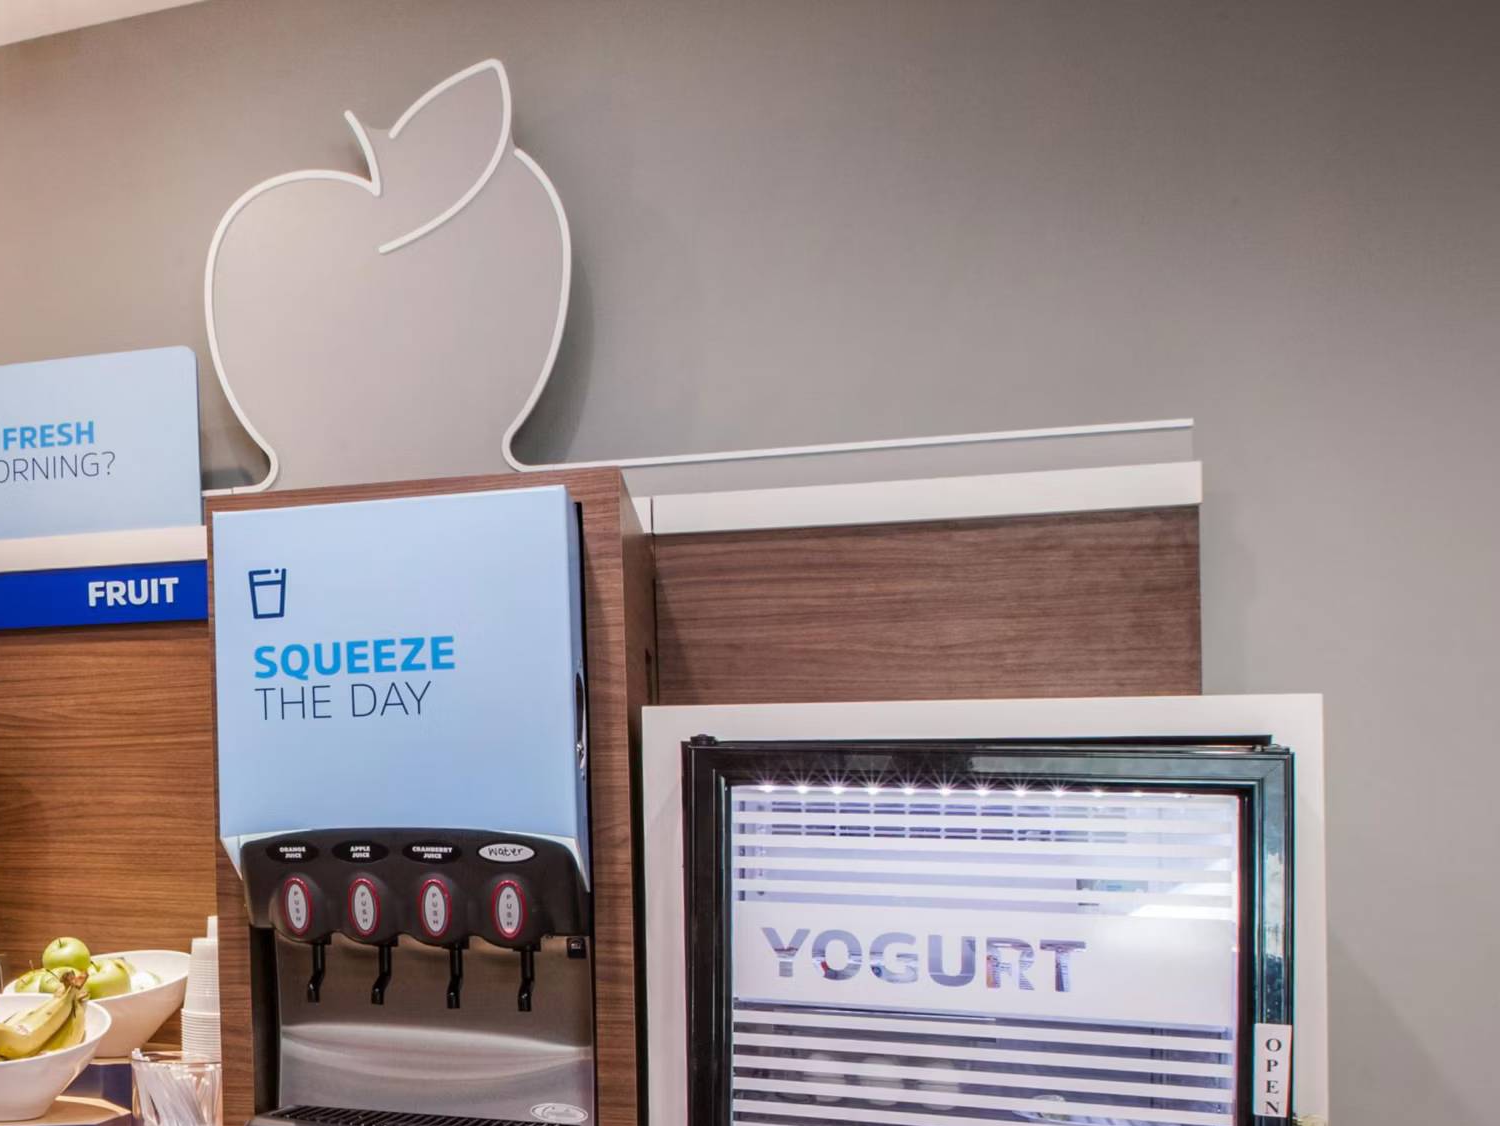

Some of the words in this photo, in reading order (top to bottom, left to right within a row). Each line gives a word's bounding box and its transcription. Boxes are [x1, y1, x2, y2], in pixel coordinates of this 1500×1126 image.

[3, 421, 95, 451] FRESH
[88, 577, 179, 607] FRUIT
[254, 635, 456, 681] SQUEEZE
[254, 684, 332, 720] THE
[351, 680, 431, 717] DAY
[761, 926, 1087, 992] YOGURT
[1265, 1038, 1282, 1115] OPEN
